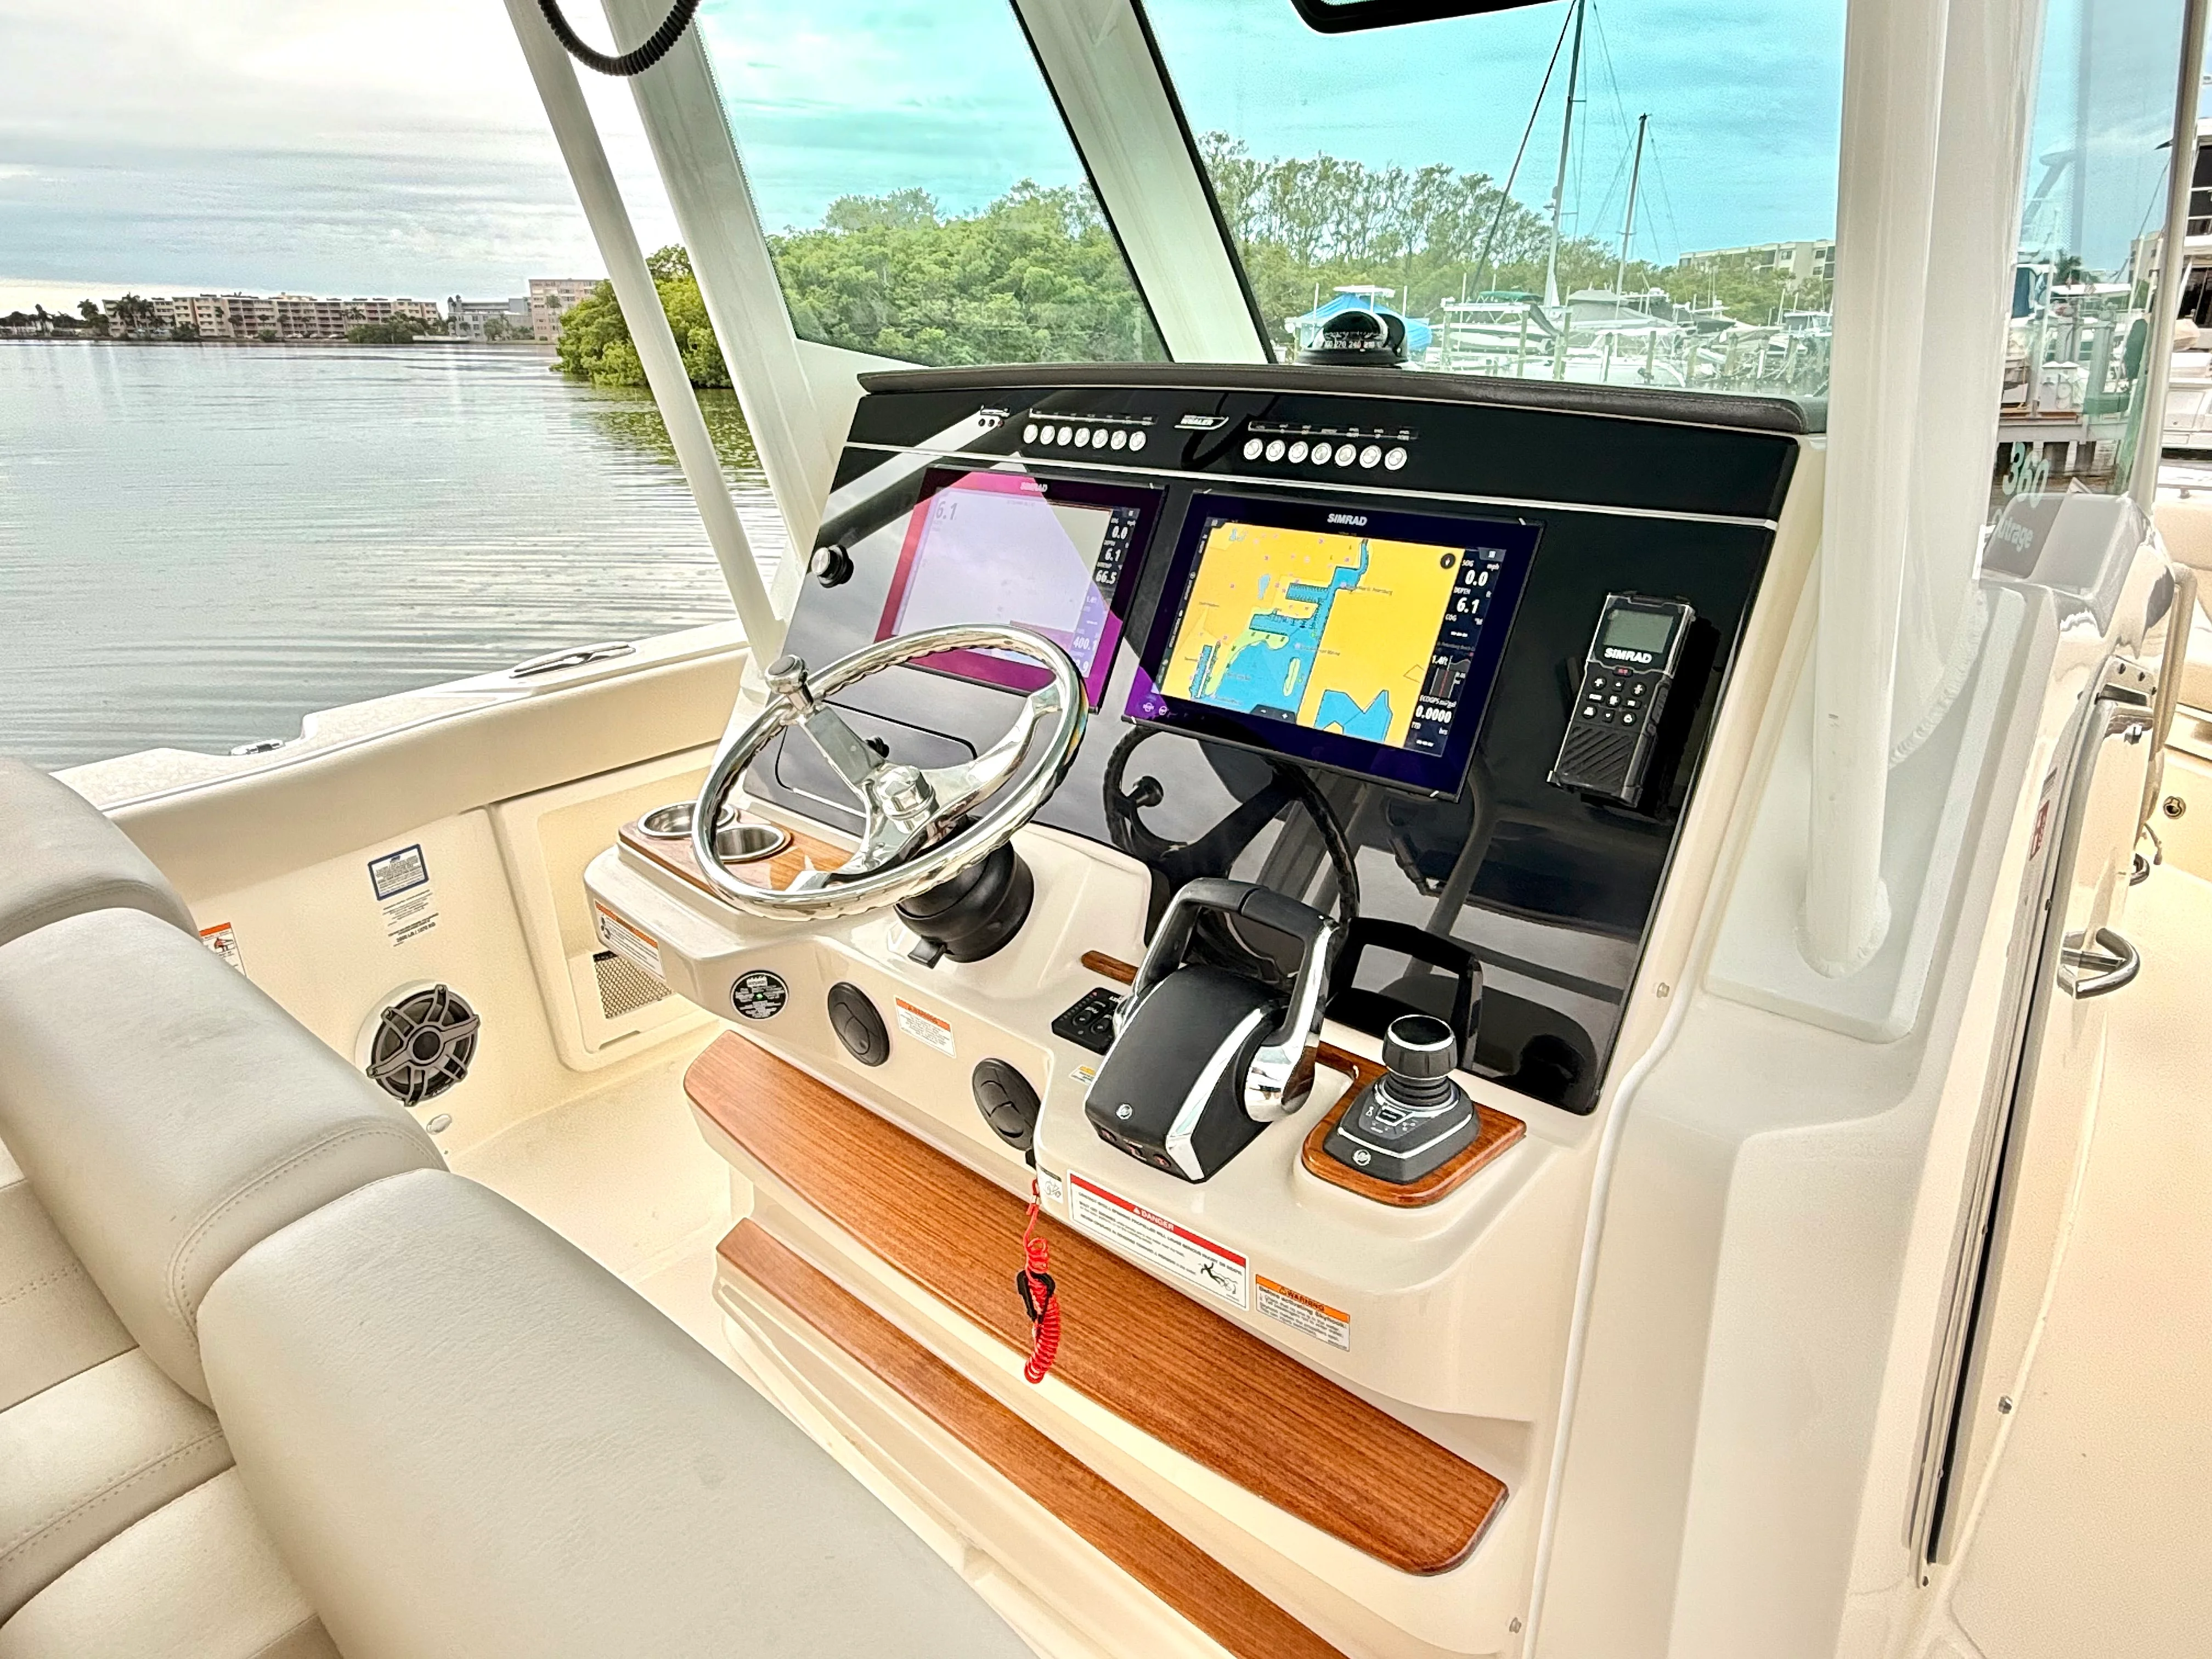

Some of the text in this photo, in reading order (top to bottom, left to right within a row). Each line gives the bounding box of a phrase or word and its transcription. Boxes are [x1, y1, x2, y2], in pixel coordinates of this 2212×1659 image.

[2002, 441, 2050, 508] 360
[936, 500, 958, 521] 6.1
[1327, 513, 1368, 526] SIMRAD
[1111, 526, 1128, 540] 0.0
[1992, 508, 2034, 552] Outrage
[1105, 548, 1121, 562] 6.1
[1096, 569, 1118, 585] 66.5
[1465, 569, 1488, 586] 0.0
[1457, 597, 1480, 614] 6.1
[1604, 647, 1652, 664] SIMRAD
[1415, 704, 1452, 724] 0.0000
[1141, 1210, 1174, 1231] DANGER
